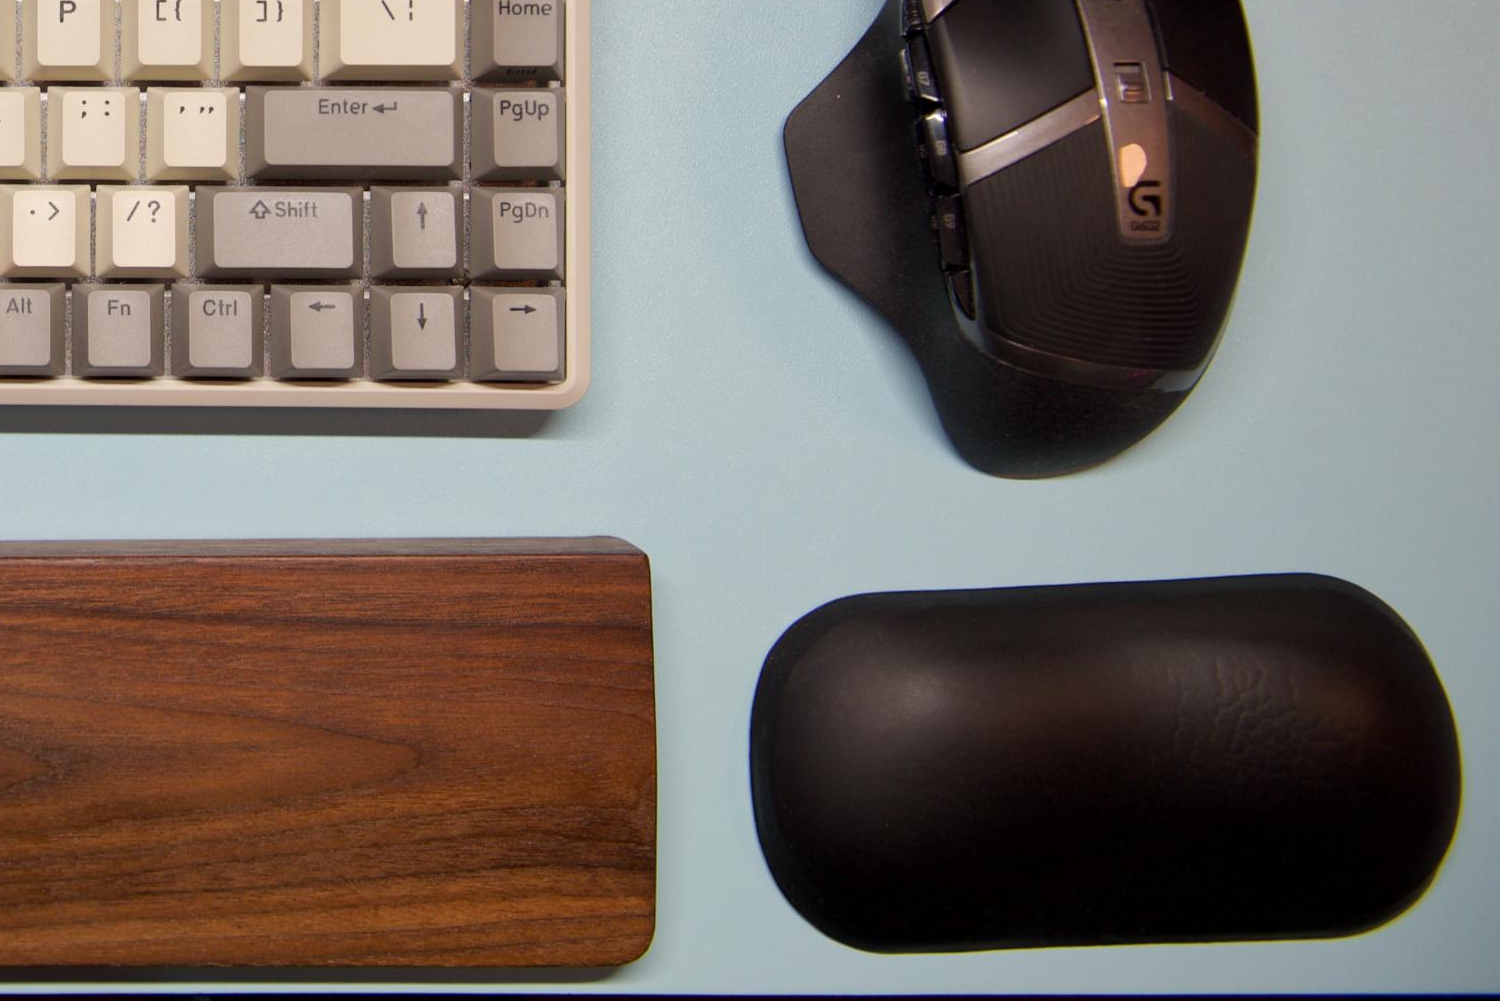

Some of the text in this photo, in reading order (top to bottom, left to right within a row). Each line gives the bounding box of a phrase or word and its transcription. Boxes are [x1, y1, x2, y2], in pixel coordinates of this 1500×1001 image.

[59, 0, 77, 24] P
[498, 0, 553, 16] Home
[318, 98, 369, 115] Enter
[499, 99, 550, 123] PgUp
[274, 200, 318, 219] Shift
[499, 201, 549, 224] PgDn
[5, 297, 33, 315] Alt
[107, 299, 131, 317] Fn
[202, 298, 238, 317] Ctrl
